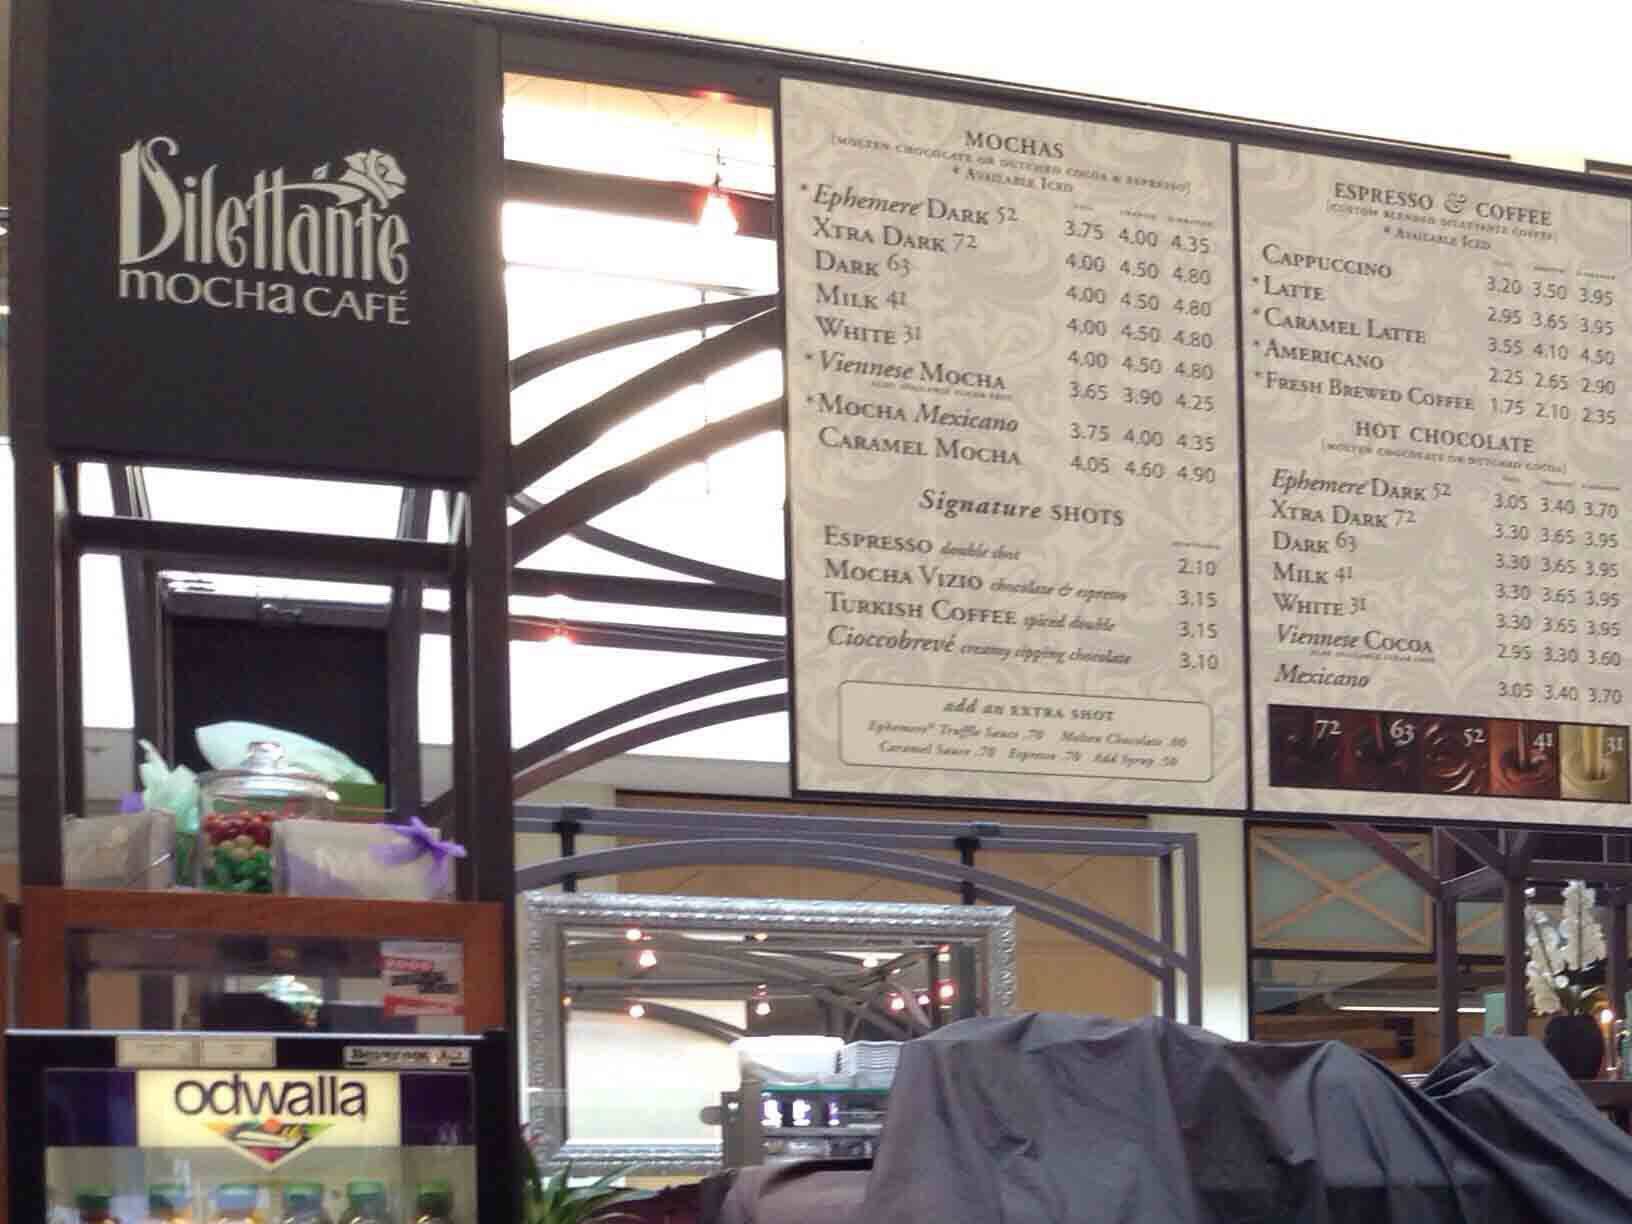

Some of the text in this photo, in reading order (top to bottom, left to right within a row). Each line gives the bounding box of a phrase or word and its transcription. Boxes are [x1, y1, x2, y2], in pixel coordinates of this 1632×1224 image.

[964, 131, 1065, 159] MOCHAS
[119, 137, 410, 285] Dilettante
[812, 183, 1017, 225] Ephemere DARK 52
[1334, 182, 1552, 227] ESPRESSO & COFFEE
[812, 216, 977, 253] XTRA DARK 72
[1065, 221, 1210, 254] 3.75 4.00 4.35
[815, 250, 910, 278] DARK 63
[1066, 253, 1211, 286] 4.00 4.50 4.80
[1262, 243, 1392, 278] CAPPUCCINO
[816, 283, 879, 310] MILK
[1263, 275, 1326, 301] LATTE
[1488, 276, 1613, 306] 3.20 3.50 3.95
[303, 290, 410, 324] CAFÉ
[816, 316, 921, 345] WHITE 31
[1264, 306, 1426, 344] CARAMEL LATTE
[1264, 338, 1384, 370] AMERICANO
[819, 350, 1005, 390] Viennese MOCHA
[1489, 368, 1615, 395] 2.25 2.65 2.90
[1069, 382, 1214, 411] 3.65 3.90 4.25
[1264, 370, 1474, 411] FRESH BREWED COFFEE
[818, 392, 1019, 432] MOCHA Mexicano
[1489, 398, 1616, 424] 1.75 2.10 2.35
[819, 426, 1021, 466] CARAMEL MOCHA
[1356, 421, 1536, 453] HOT CHOCOLATE
[1071, 455, 1216, 484] 4.05 4.60 4.90
[1272, 468, 1451, 502] Ephemere DARK 52
[918, 489, 1124, 527] Signature SHOTS
[1271, 500, 1324, 522] XTRA
[1332, 505, 1388, 528] DARK
[1494, 494, 1618, 519] 3.05 3.40 3.70
[823, 525, 932, 554] ESPRESSO
[1273, 531, 1357, 554] DARK 63
[824, 558, 912, 585] MOCHA
[920, 566, 983, 591] VIZIO
[1178, 558, 1217, 577] 2.10
[1273, 562, 1352, 585] MILK 41
[826, 591, 923, 619] TURKISH
[932, 600, 1017, 625] COFFEE
[1273, 592, 1344, 616] WHITE
[1276, 623, 1432, 654] Viennese COCOA
[1180, 654, 1219, 670] 3.10
[1274, 663, 1370, 688] Mexicano
[1314, 719, 1343, 738] 72
[1390, 719, 1416, 746] 63
[1464, 728, 1485, 746] 52
[1533, 732, 1553, 748] 41
[174, 1073, 368, 1119] odwalla
